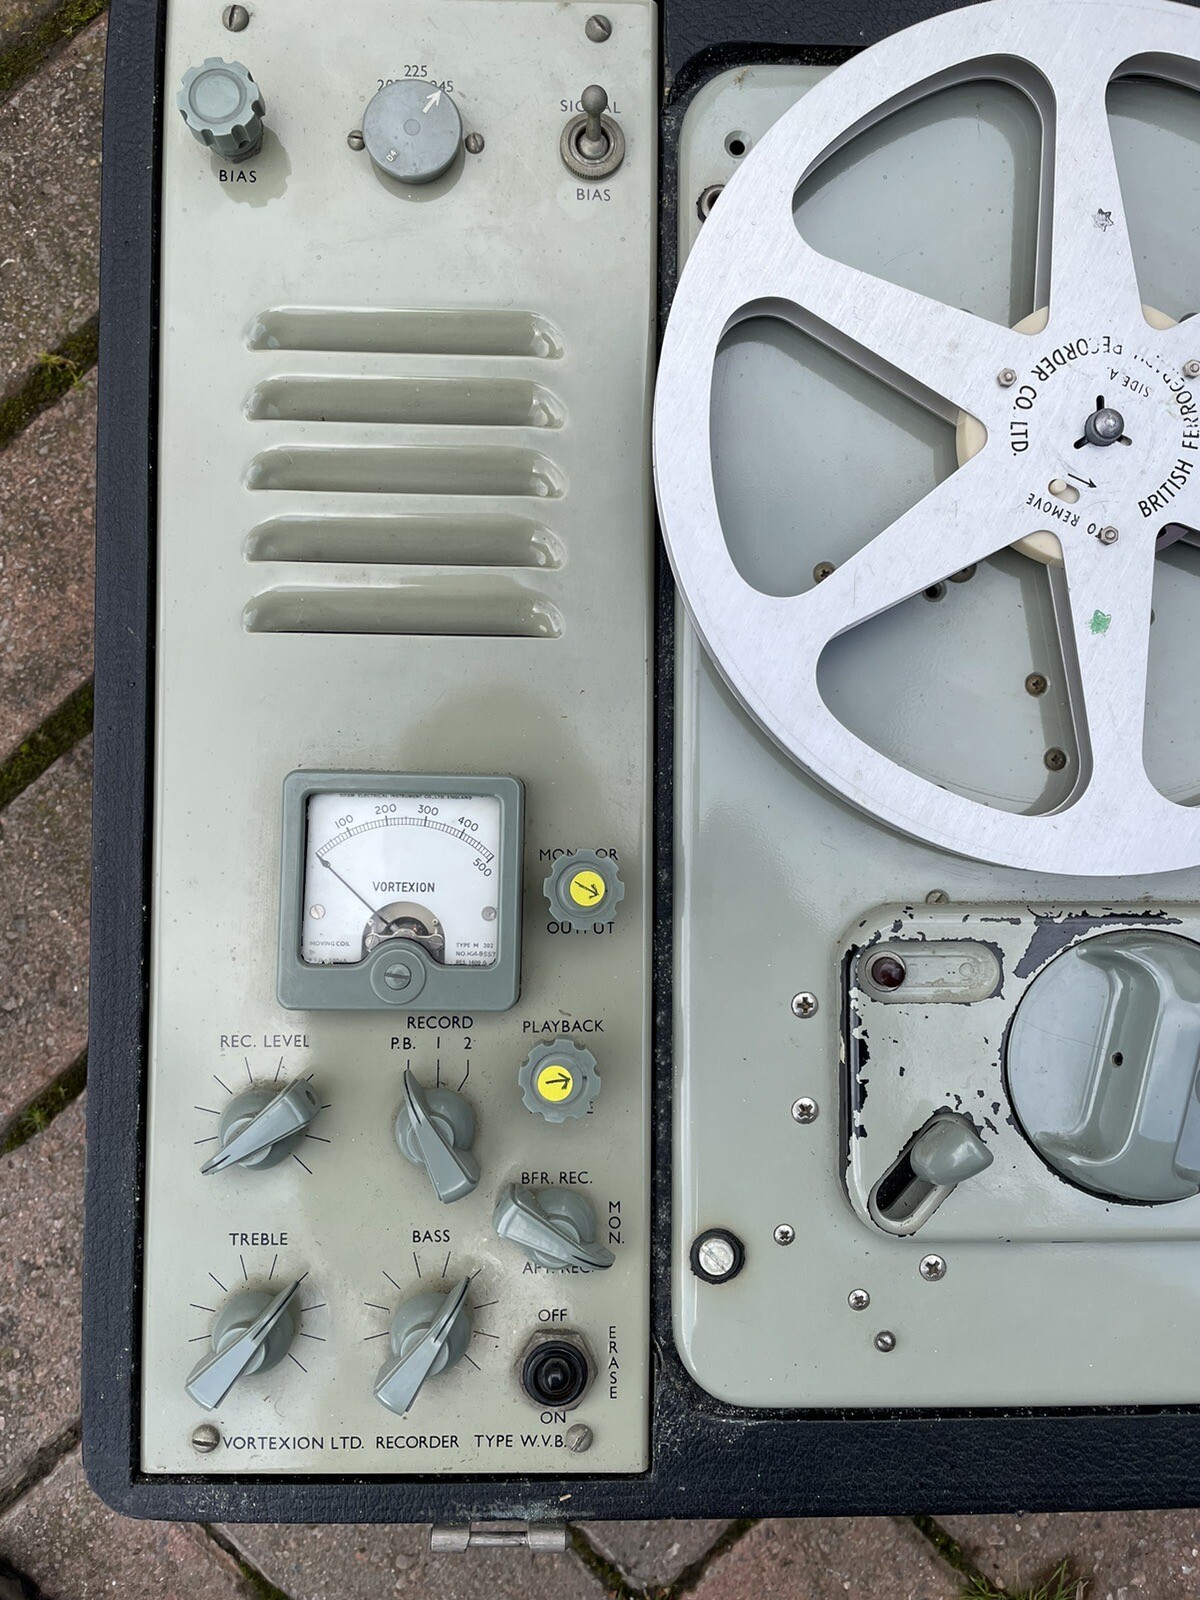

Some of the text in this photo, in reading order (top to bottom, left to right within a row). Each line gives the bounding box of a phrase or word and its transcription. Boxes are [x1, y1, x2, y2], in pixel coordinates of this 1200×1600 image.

[404, 65, 427, 77] 225
[219, 169, 257, 183] BIAS
[576, 188, 611, 201] BIAS
[1122, 375, 1151, 397] SIDE
[1013, 385, 1037, 410] CO.
[1010, 422, 1029, 456] LTD.
[1138, 459, 1194, 518] BRITISH
[1026, 493, 1080, 527] REMOVE
[375, 803, 397, 815] 200
[417, 804, 439, 816] 300
[335, 815, 353, 829] 100
[457, 816, 479, 831] 400
[540, 848, 618, 861] MONOR
[472, 858, 492, 877] 500
[373, 881, 435, 893] VORTEXION
[547, 921, 614, 934] OUUT
[406, 1016, 474, 1029] RECORD
[523, 1020, 604, 1033] PLAYBACK
[220, 1034, 309, 1048] REC. LEVEL
[391, 1037, 416, 1050] P.B.
[463, 1036, 472, 1049] 2
[521, 1171, 593, 1184] BFR. REC.
[608, 1201, 624, 1244] MON.
[229, 1233, 288, 1246] TREBLE
[412, 1230, 450, 1243] BASS
[538, 1308, 567, 1322] OFF
[609, 1326, 618, 1400] ERASE
[540, 1411, 566, 1424] ON
[223, 1434, 567, 1450] VORTEXION LTD. RECORDER TYPE W.V.B.
